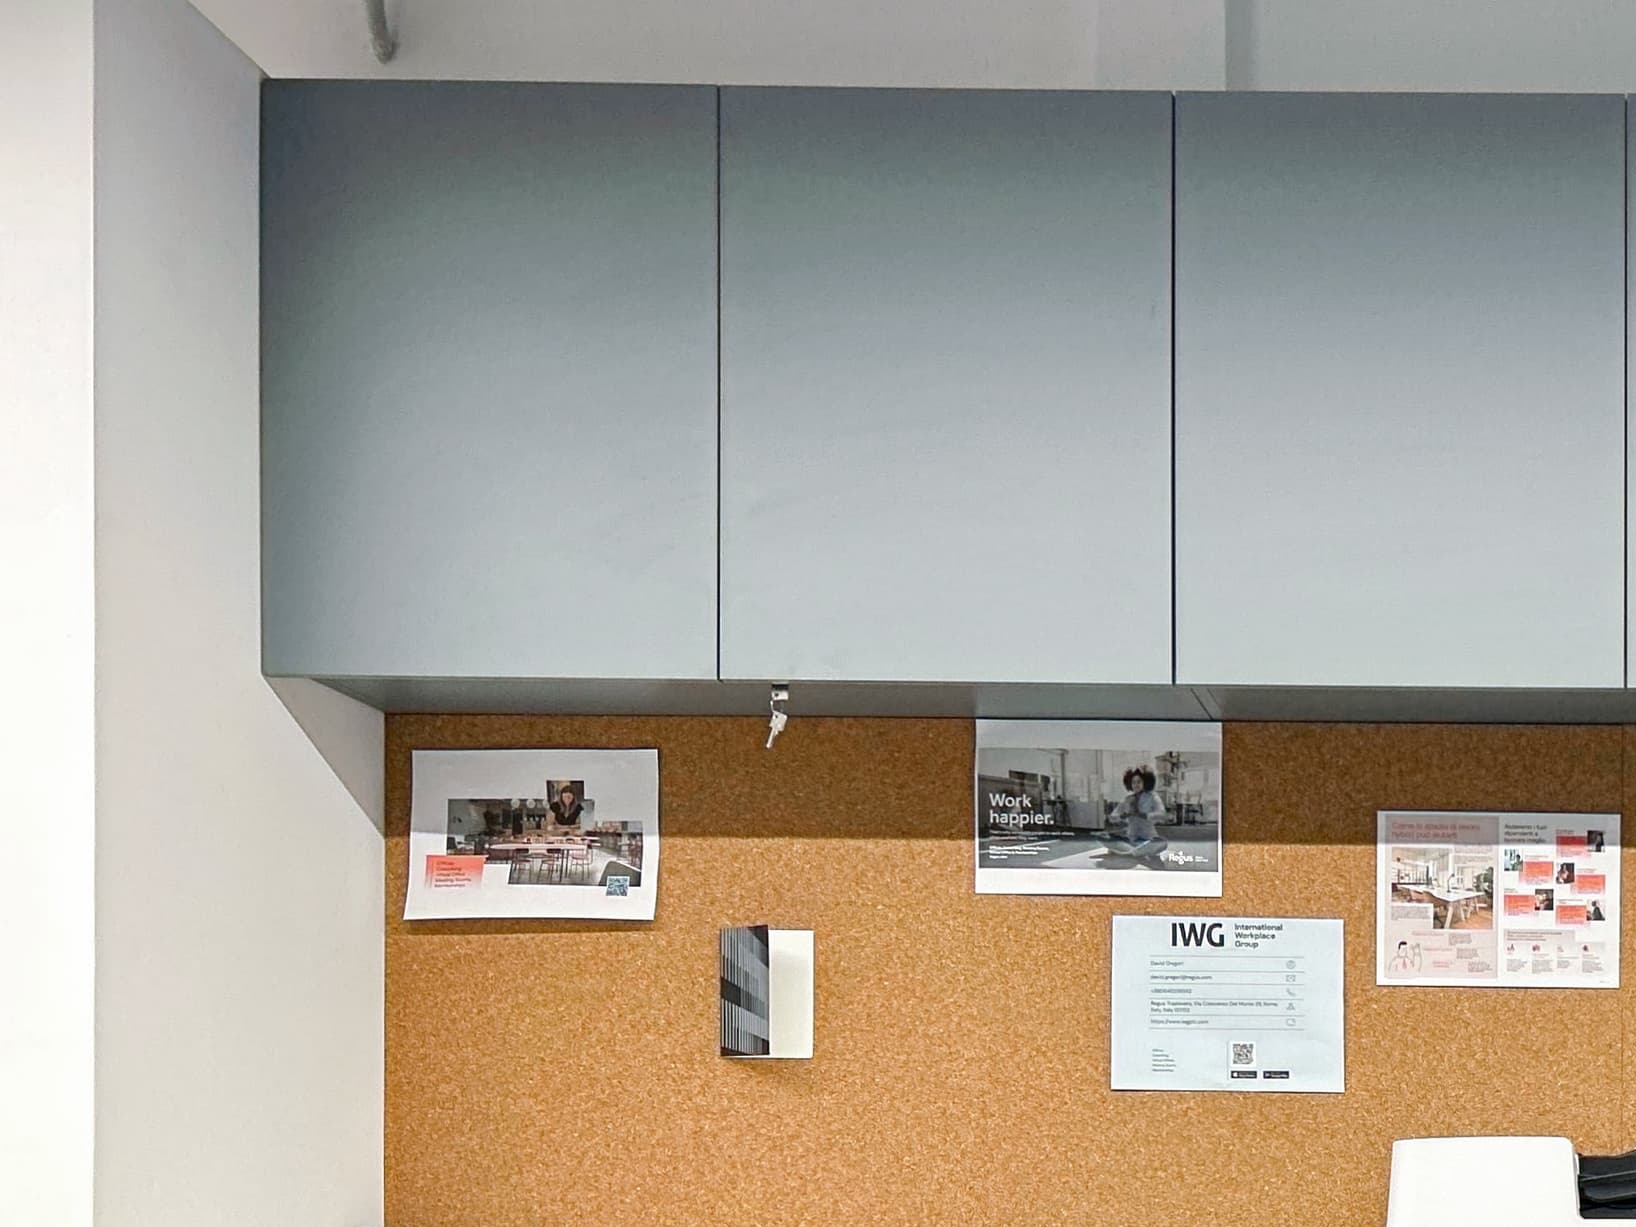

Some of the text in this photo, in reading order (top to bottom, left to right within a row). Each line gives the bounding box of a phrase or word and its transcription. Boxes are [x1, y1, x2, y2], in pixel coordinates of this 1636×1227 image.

[989, 793, 1032, 808] Work
[989, 810, 1055, 828] happier.
[1234, 923, 1283, 931] International
[1171, 922, 1225, 947] IWG
[1235, 932, 1276, 940] Workplace
[1235, 941, 1259, 949] Group
